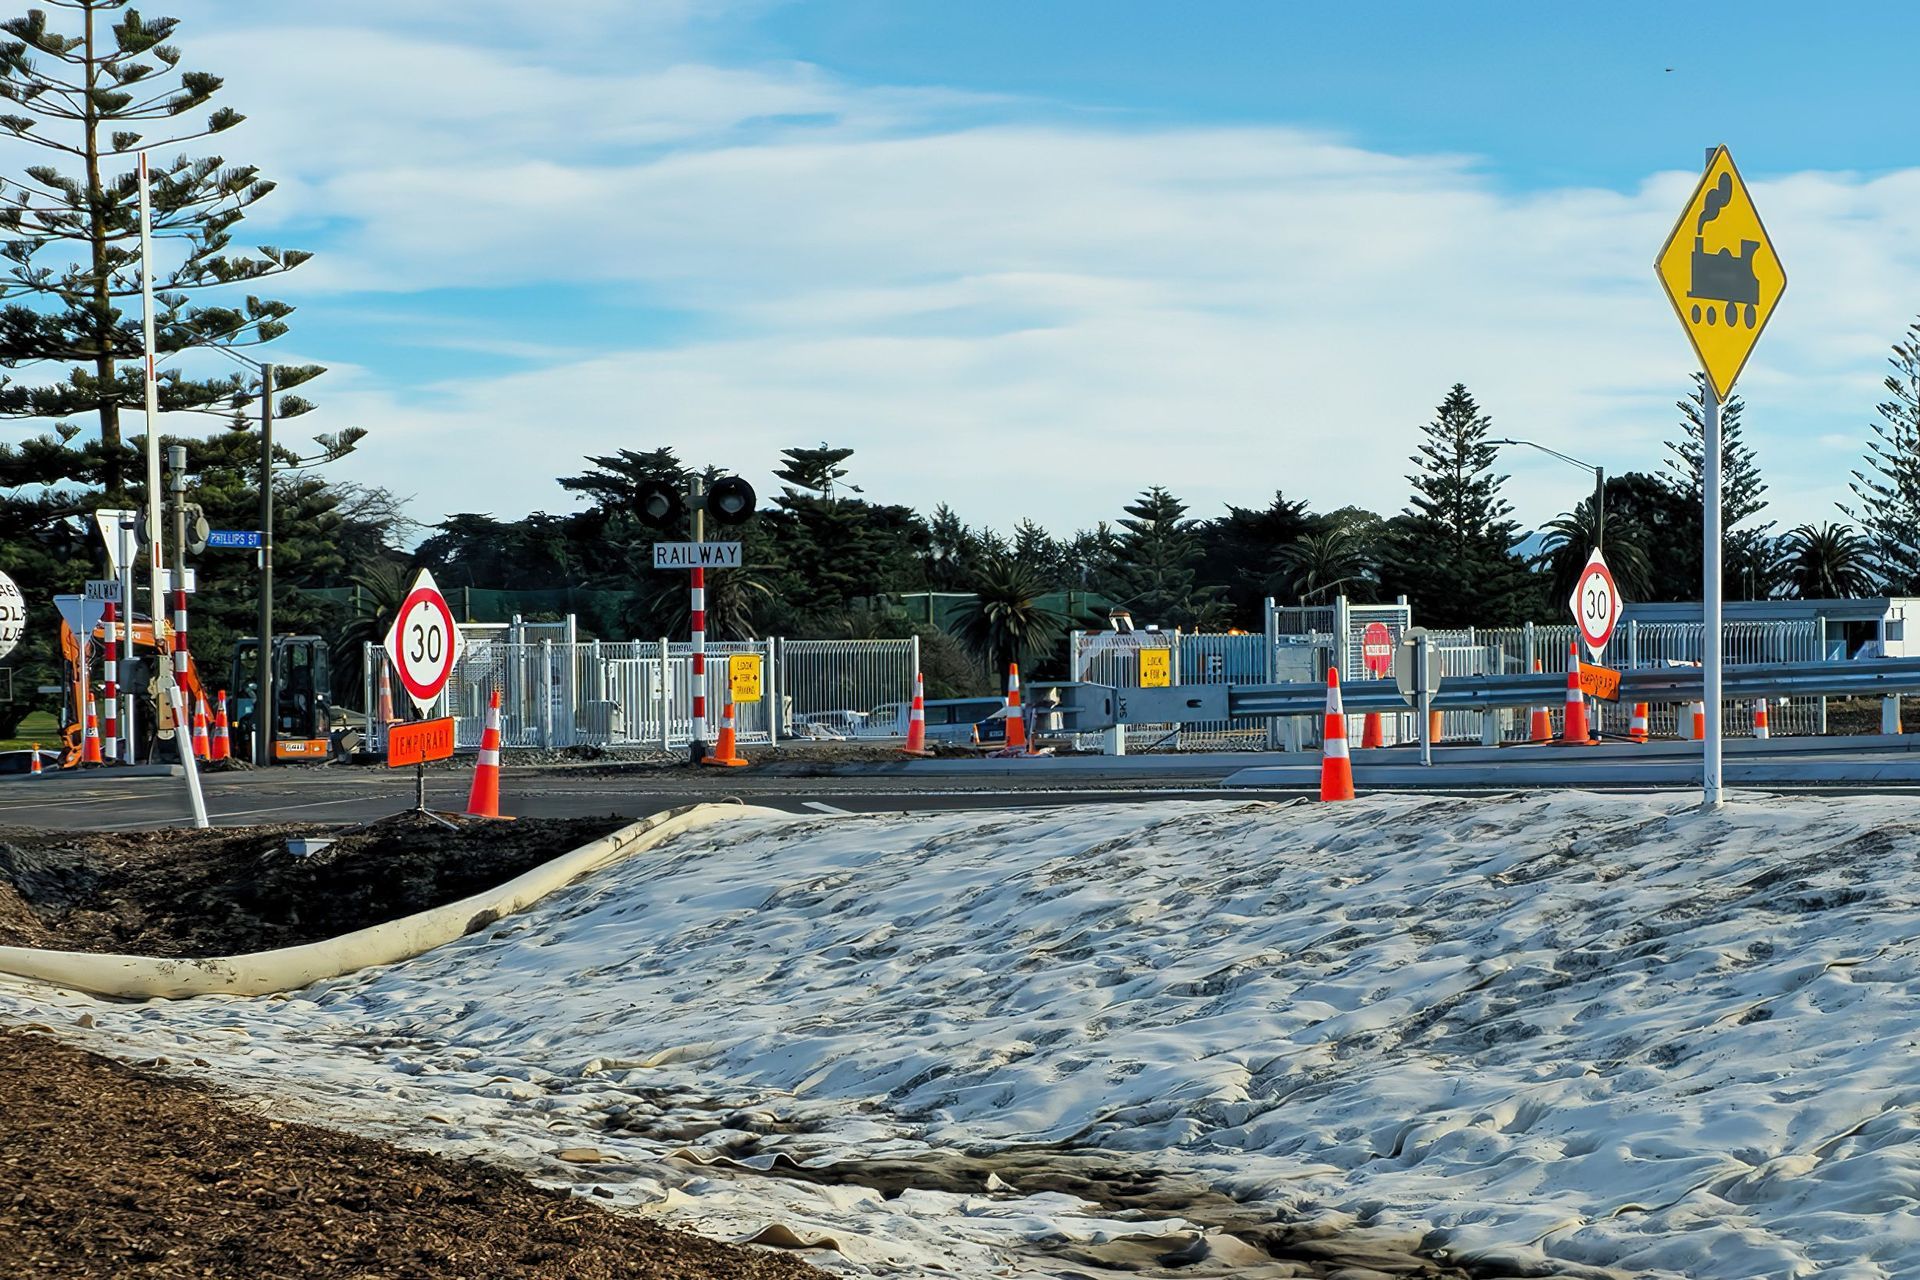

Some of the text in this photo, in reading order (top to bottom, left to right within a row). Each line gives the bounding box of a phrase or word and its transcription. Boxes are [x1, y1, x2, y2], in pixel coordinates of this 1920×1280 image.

[210, 533, 257, 545] PHILLIPS ST
[657, 546, 738, 564] RAILWAY
[1586, 590, 1607, 619] 30
[411, 624, 441, 663] 30
[394, 729, 449, 756] TEMPORARY
